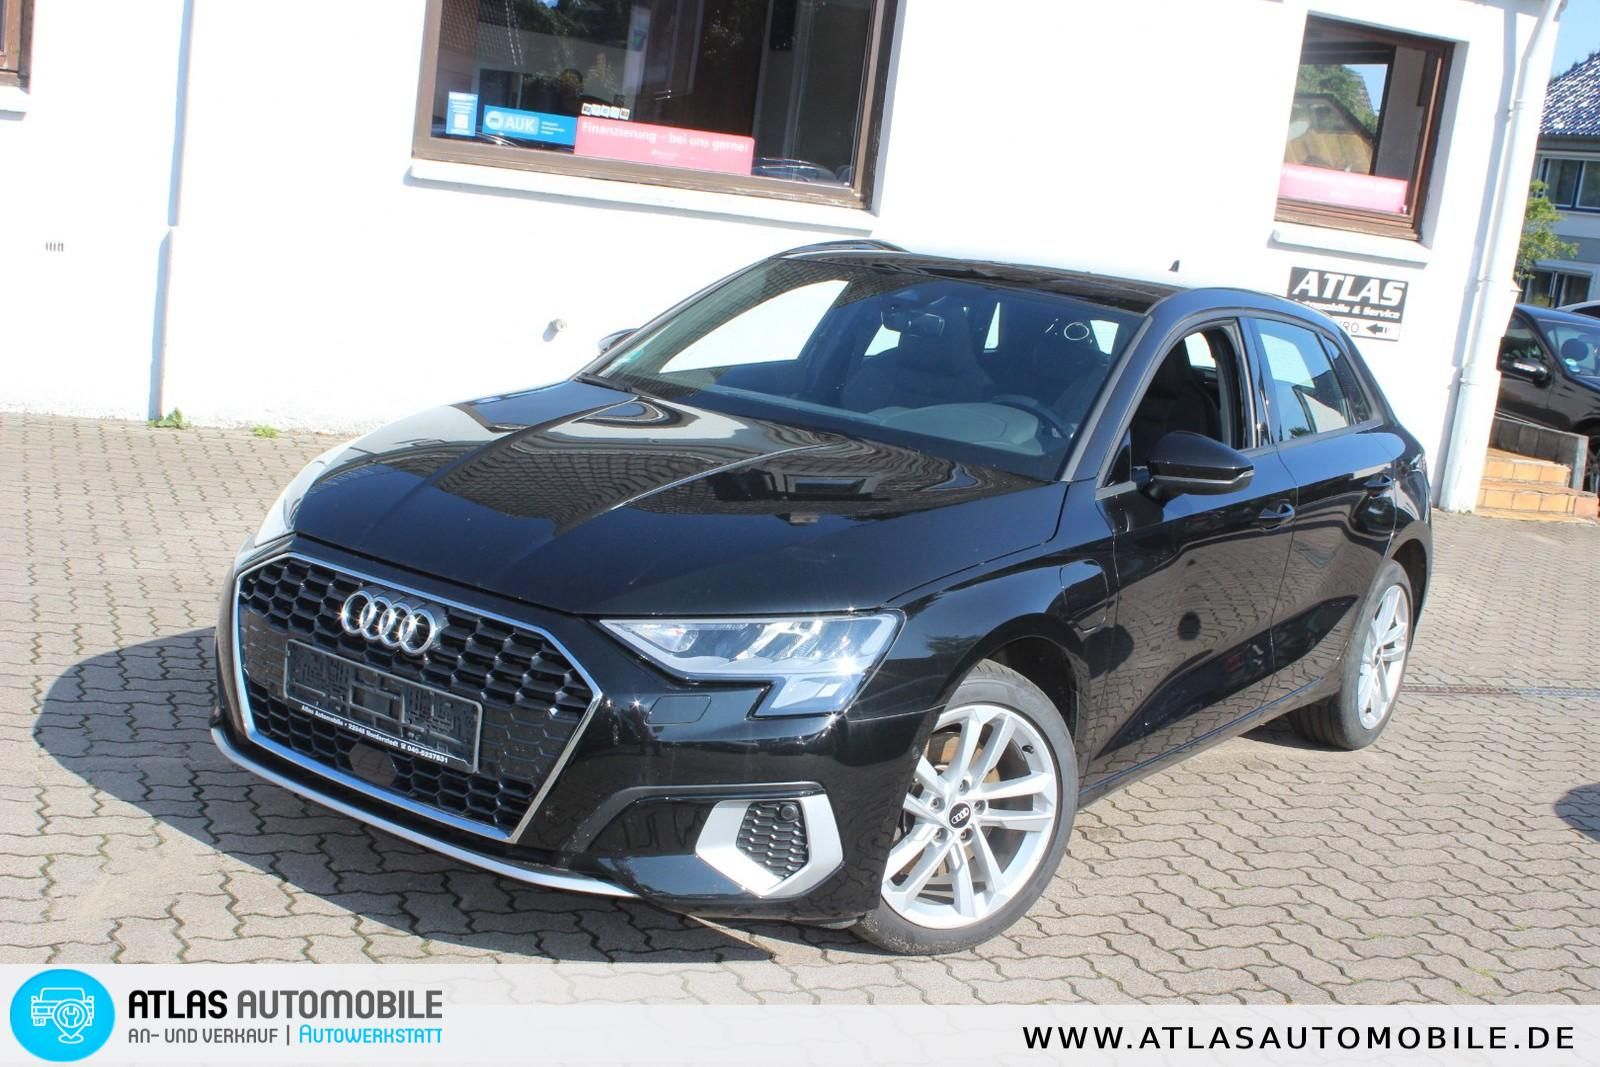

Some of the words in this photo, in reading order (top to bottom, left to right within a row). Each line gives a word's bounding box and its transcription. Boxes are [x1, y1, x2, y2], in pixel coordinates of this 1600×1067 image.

[503, 113, 535, 134] AUK
[582, 122, 658, 144] Finanzierung
[669, 132, 688, 146] bei
[689, 138, 710, 149] uns
[712, 141, 749, 154] gerne!
[1292, 271, 1405, 306] ATLAS
[1351, 306, 1361, 315] &
[1363, 307, 1400, 318] Service
